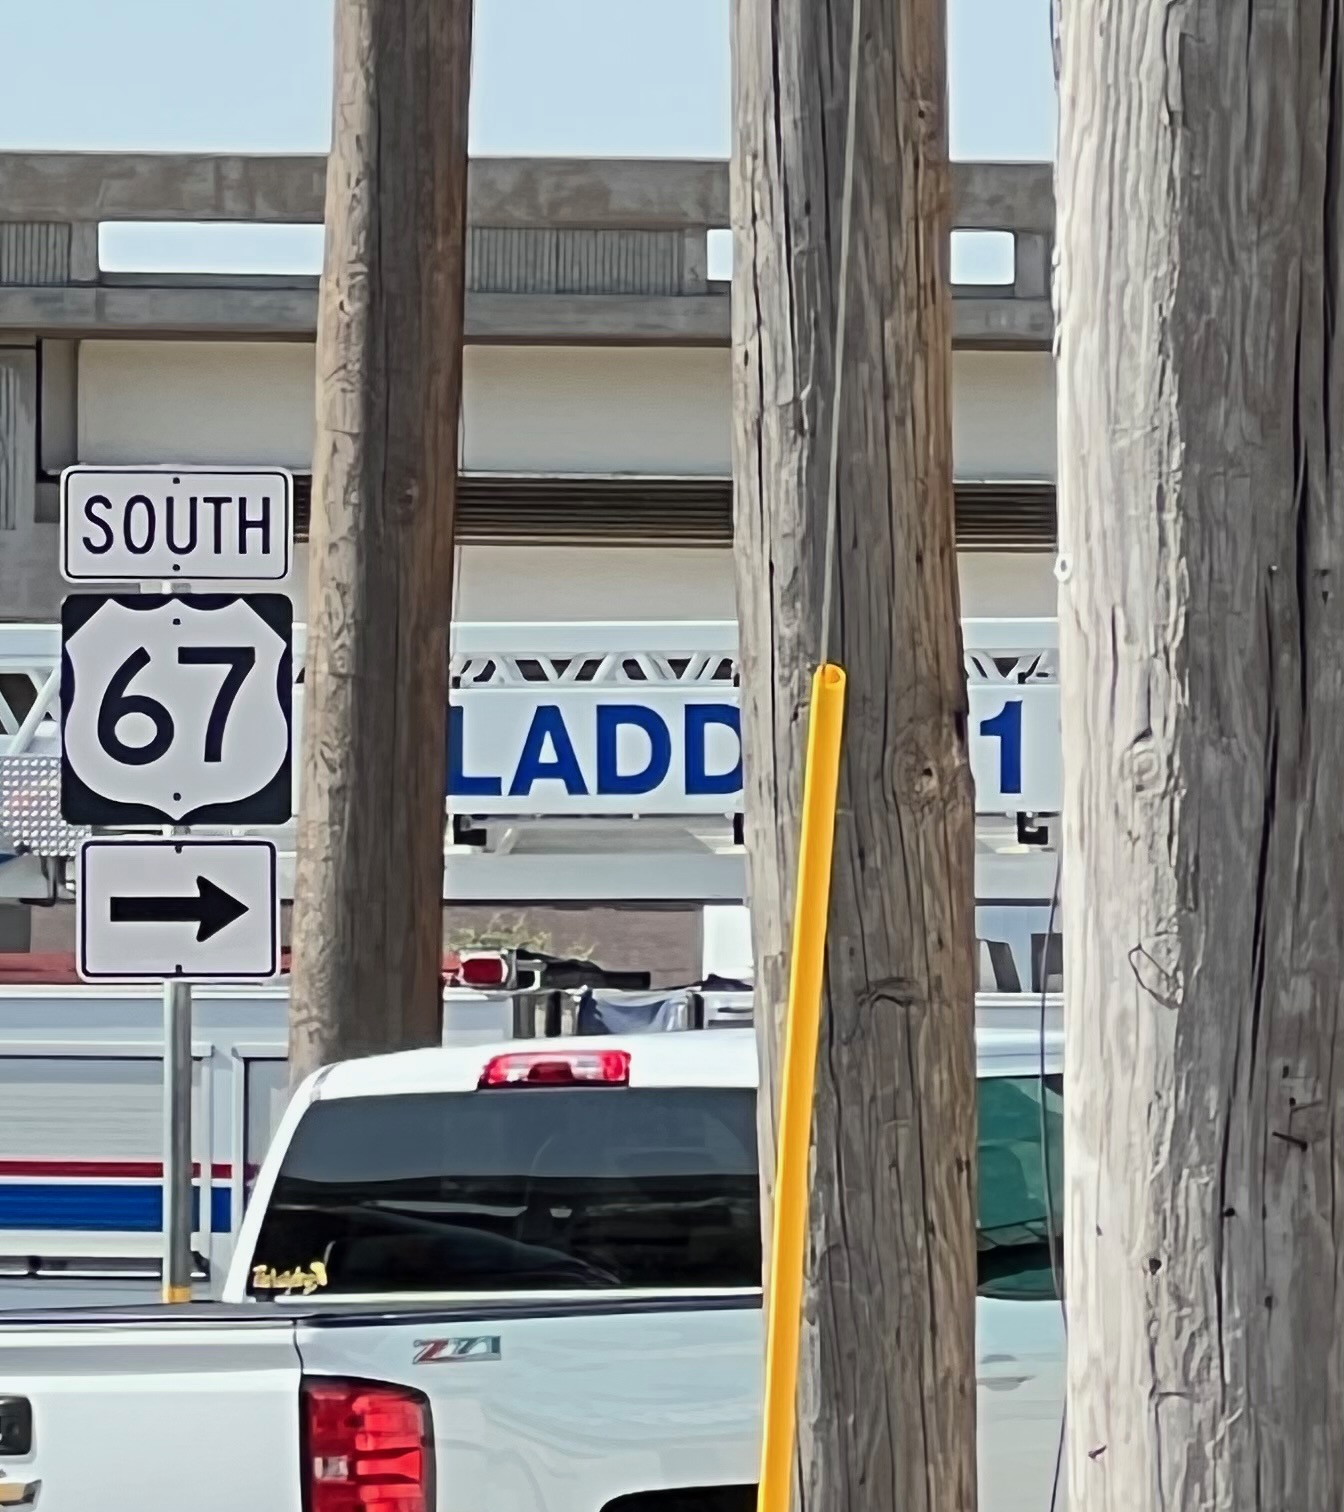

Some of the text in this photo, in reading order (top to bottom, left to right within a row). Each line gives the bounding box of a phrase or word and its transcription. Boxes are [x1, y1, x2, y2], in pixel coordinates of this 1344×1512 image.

[82, 494, 271, 556] SOUTH
[96, 645, 256, 766] 67
[448, 700, 1024, 797] LADD 1
